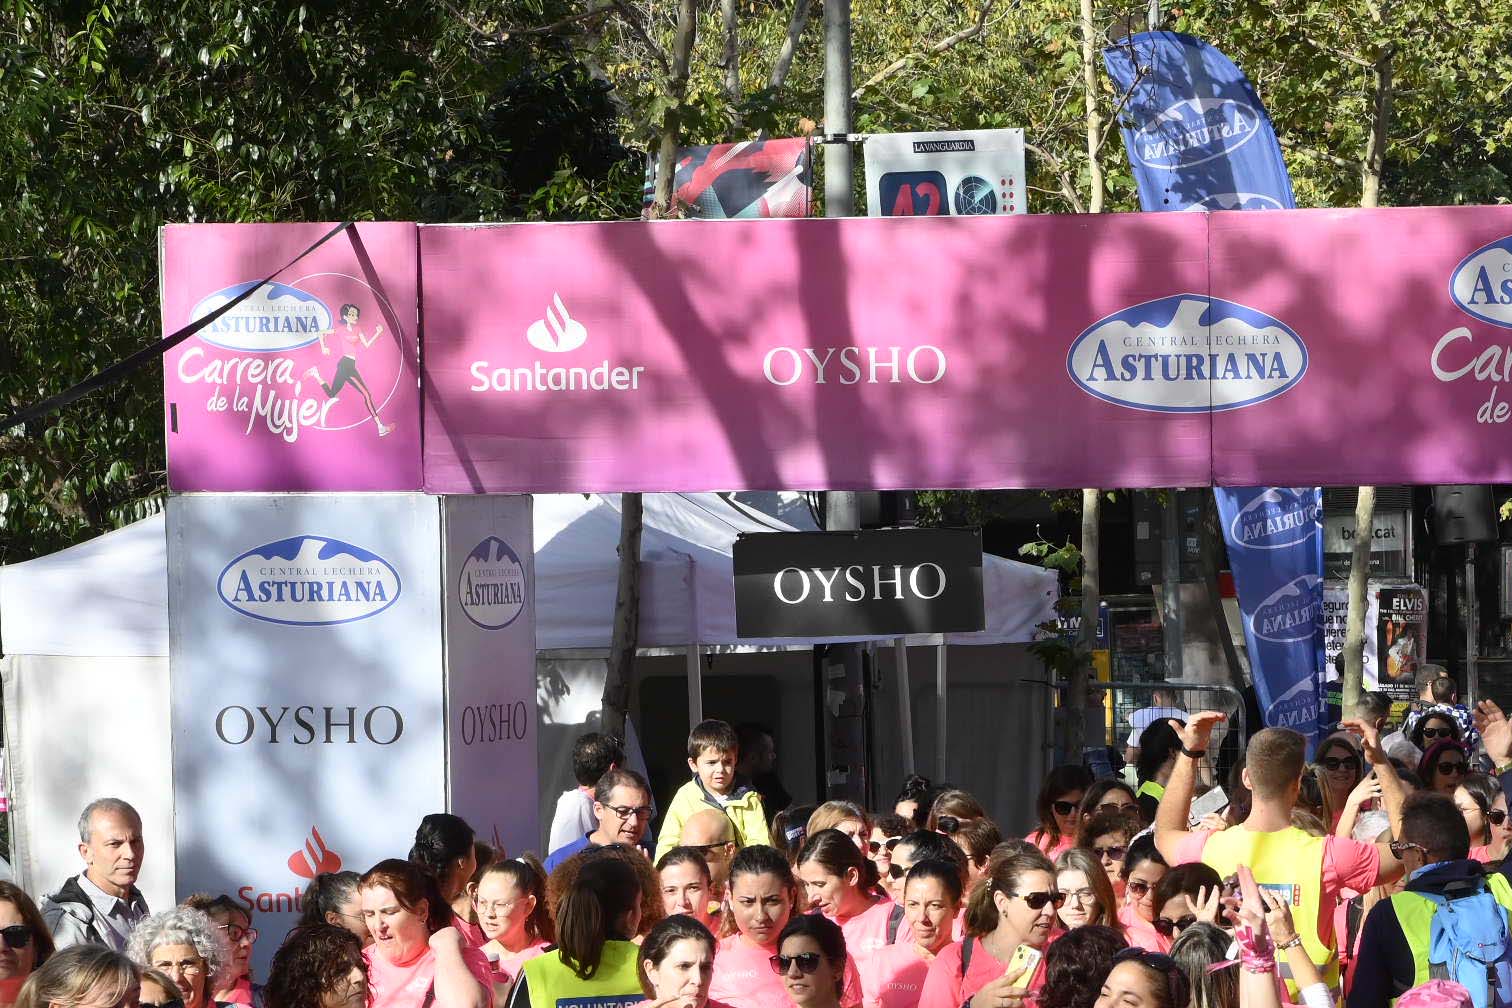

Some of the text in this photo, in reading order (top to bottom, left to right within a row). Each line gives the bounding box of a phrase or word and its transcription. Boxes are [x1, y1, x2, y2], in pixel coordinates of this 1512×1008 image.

[204, 309, 321, 335] ASTURIANA
[1123, 334, 1282, 348] CENTRAL LECHERA
[177, 346, 296, 385] Carrera
[470, 358, 645, 393] Santander
[762, 344, 948, 387] OYSHO
[1085, 337, 1290, 384] ASTURIANA
[206, 382, 340, 444] de la Mujer
[1476, 383, 1509, 425] de
[231, 569, 388, 604] ASTURIANA
[259, 566, 382, 577] CENTRAL LECHERA
[464, 571, 523, 608] ASTURIANA
[773, 561, 948, 605] OYSHO
[1392, 598, 1423, 610] ELVIS
[215, 704, 405, 746] OYSHO
[460, 700, 528, 746] OYSHO
